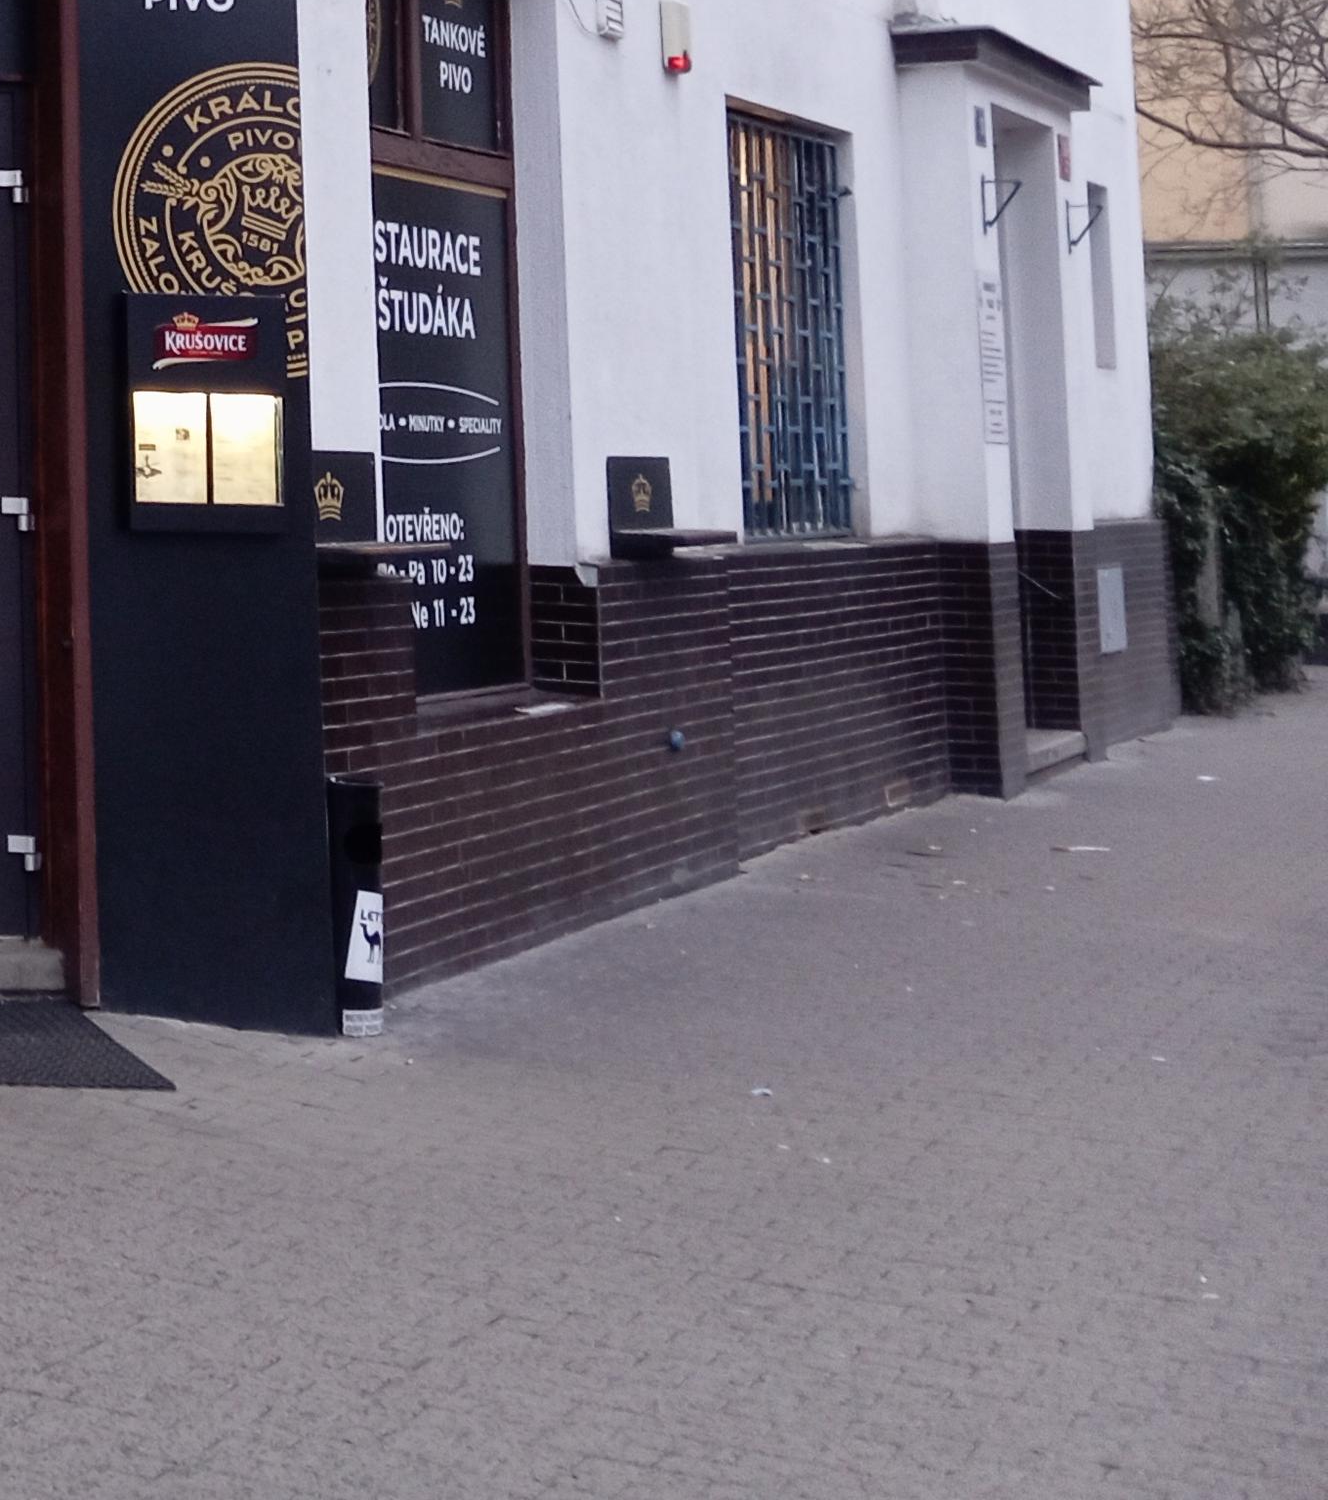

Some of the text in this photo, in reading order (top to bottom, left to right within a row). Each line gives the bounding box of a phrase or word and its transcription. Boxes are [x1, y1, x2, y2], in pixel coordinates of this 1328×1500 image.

[421, 14, 486, 58] TANKOVÉ
[439, 60, 472, 94] PIVO
[241, 231, 279, 255] 1581
[374, 220, 482, 276] STAURACE
[378, 275, 476, 339] ŠTUDÁKA
[165, 330, 247, 355] KRUŠOVICE
[385, 507, 465, 542] OTEVŘENO:
[431, 558, 447, 585] 10
[458, 554, 475, 583] 23
[433, 598, 446, 628] 11
[459, 595, 476, 625] 23
